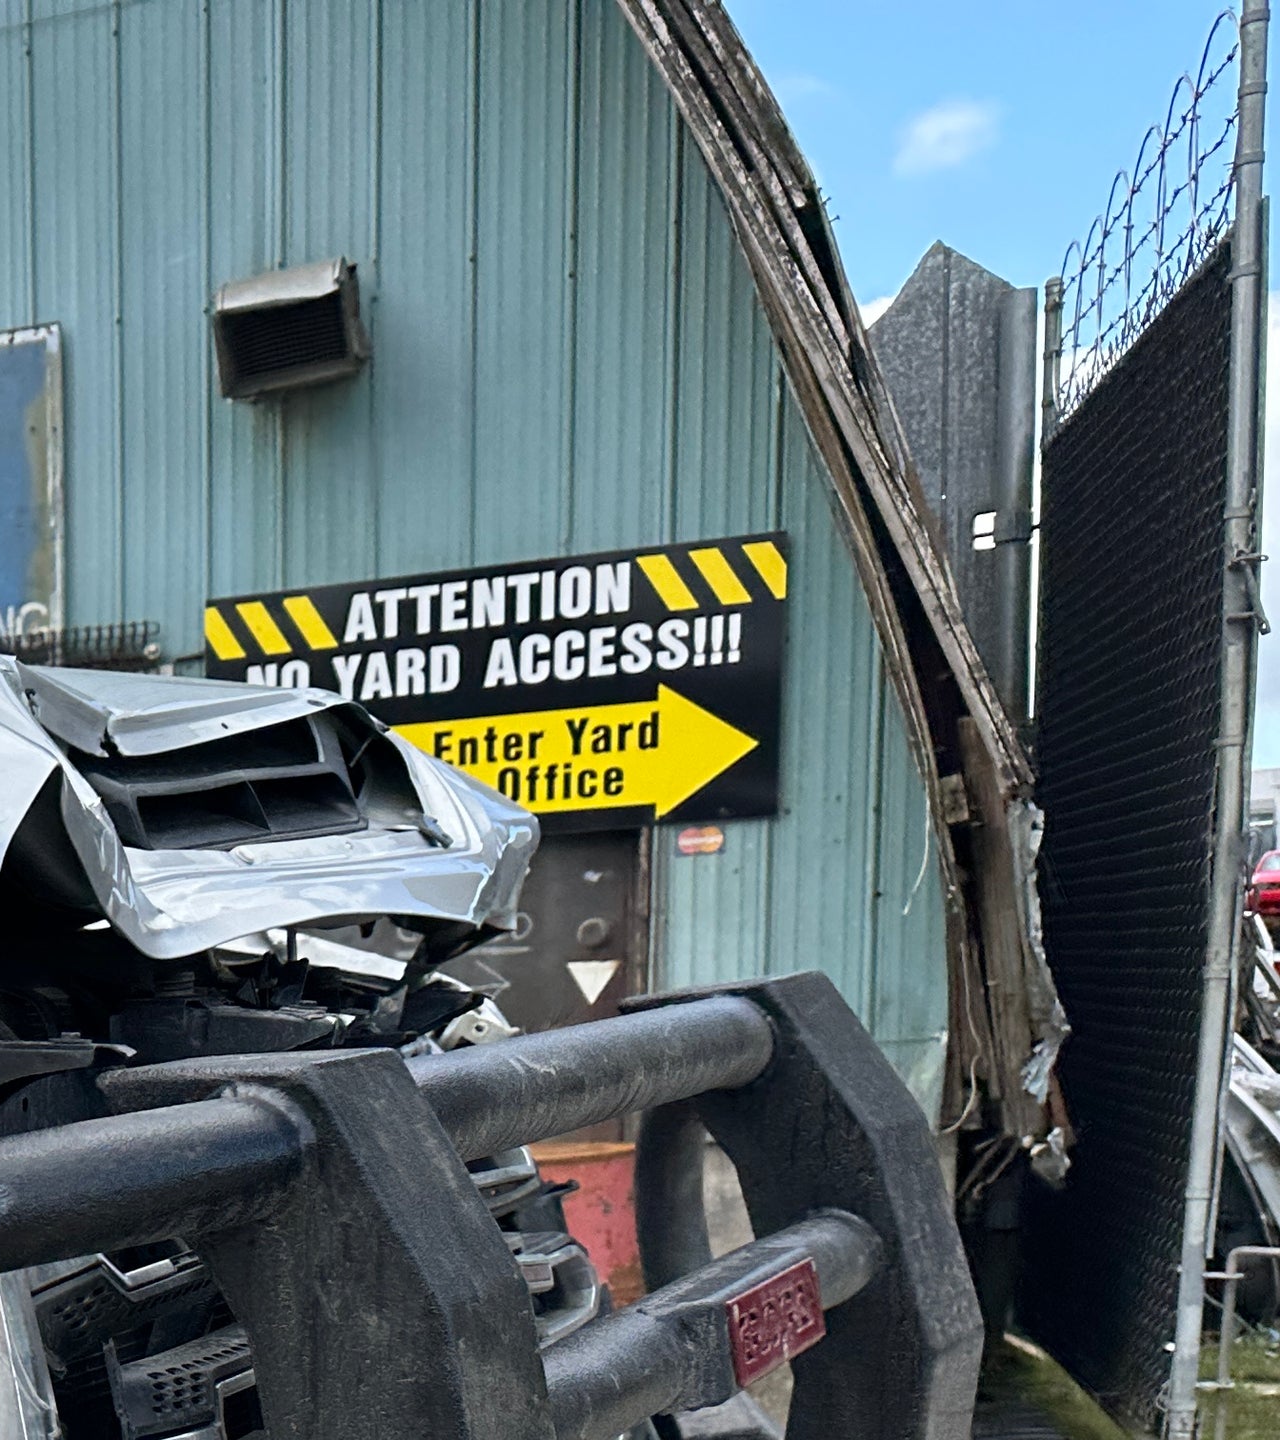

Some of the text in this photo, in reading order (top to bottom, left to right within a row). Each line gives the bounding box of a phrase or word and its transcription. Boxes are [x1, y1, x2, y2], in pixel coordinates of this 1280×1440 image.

[344, 561, 632, 643] ATTENTION
[332, 644, 461, 702] YARD
[482, 613, 742, 688] ACCESS!!!
[434, 711, 660, 766] Enter Yard
[498, 762, 624, 803] Office
